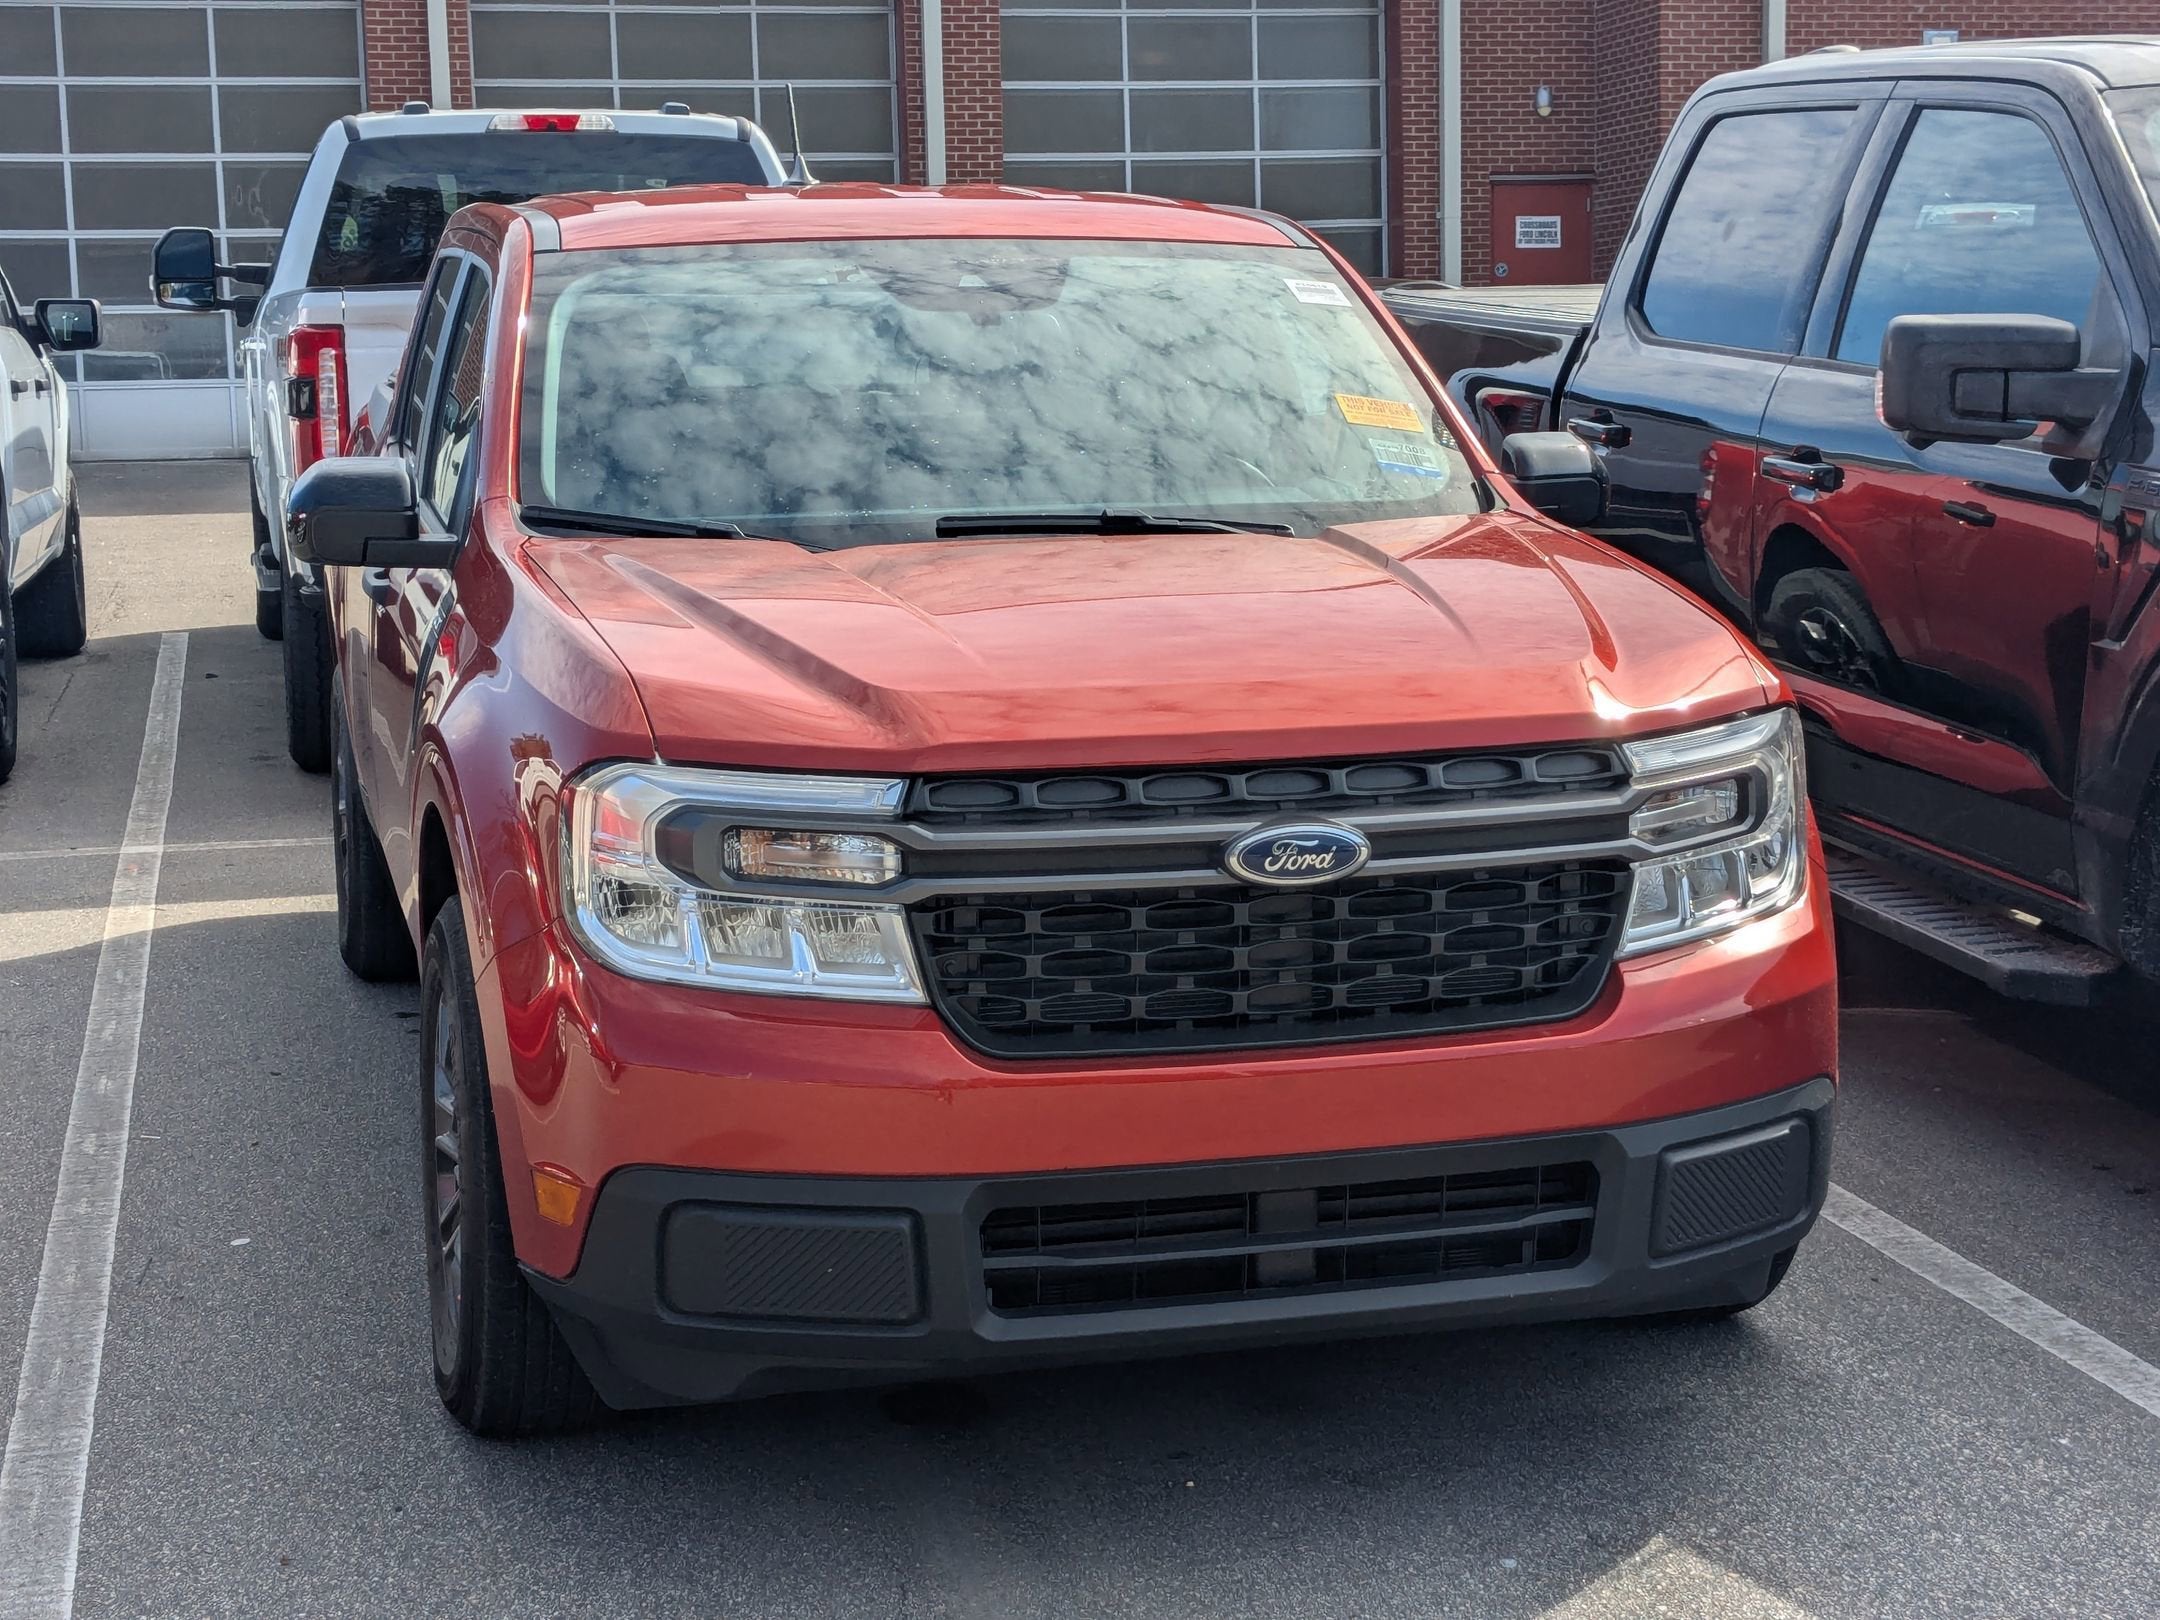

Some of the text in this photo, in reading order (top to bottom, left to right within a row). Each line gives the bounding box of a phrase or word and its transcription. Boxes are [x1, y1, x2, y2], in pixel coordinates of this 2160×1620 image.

[1519, 230, 1557, 238] FORD LINCOLN
[1342, 396, 1363, 404] THIS
[1367, 405, 1386, 414] FOR
[1389, 408, 1412, 417] SALE
[1263, 839, 1337, 872] Ford
